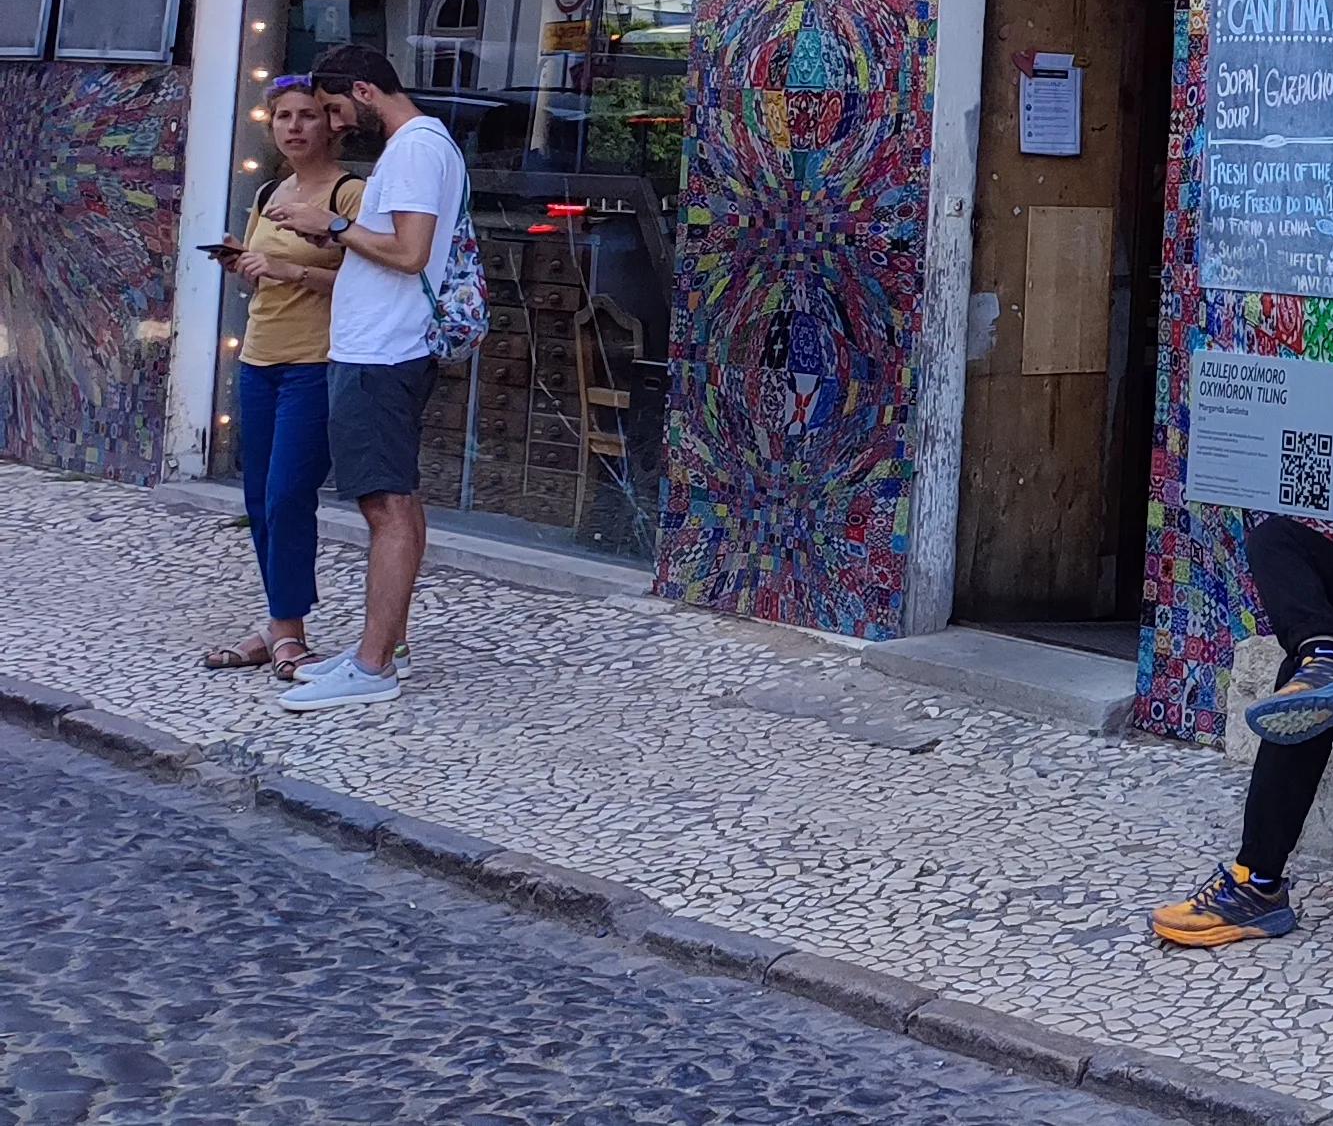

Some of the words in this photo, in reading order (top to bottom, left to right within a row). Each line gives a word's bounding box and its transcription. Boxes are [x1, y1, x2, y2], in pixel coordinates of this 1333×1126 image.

[1217, 63, 1254, 97] SOPA
[1216, 101, 1250, 130] SOUP
[1209, 154, 1248, 186] FRESH
[1253, 162, 1290, 184] CATCH
[1294, 163, 1307, 181] OF
[1307, 163, 1331, 182] THE
[1244, 189, 1281, 214] FRESCO
[1286, 196, 1300, 215] DO
[1267, 221, 1275, 238] A
[1200, 361, 1238, 383] AZULEJO
[1240, 363, 1286, 385] OXÍMORO
[1200, 381, 1253, 402] OXYMORON
[1257, 386, 1288, 405] TILING
